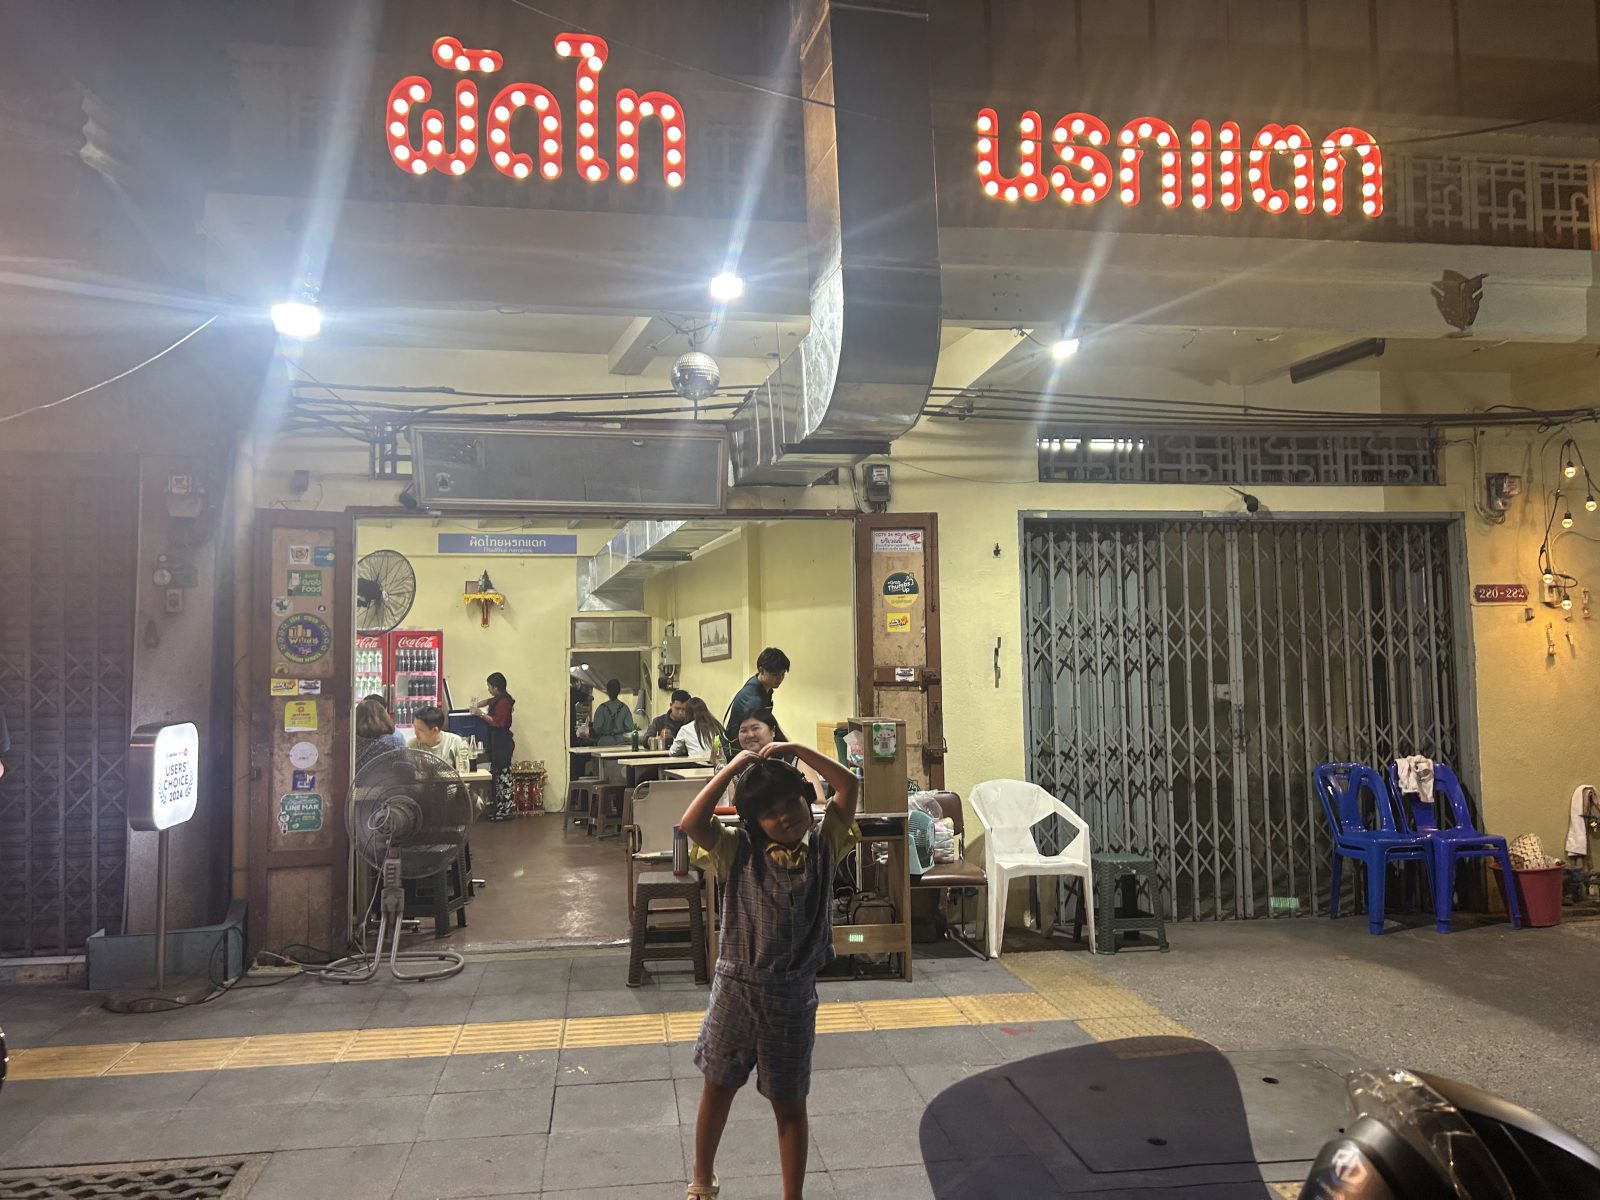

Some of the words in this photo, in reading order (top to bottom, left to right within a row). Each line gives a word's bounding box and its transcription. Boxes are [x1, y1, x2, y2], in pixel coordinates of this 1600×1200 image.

[386, 32, 686, 188] ผัดไท
[977, 107, 1383, 218] นรกแตก
[469, 535, 547, 548] ผัดไทยนรกแตก
[163, 774, 189, 791] CHOICE
[169, 790, 183, 802] 2024
